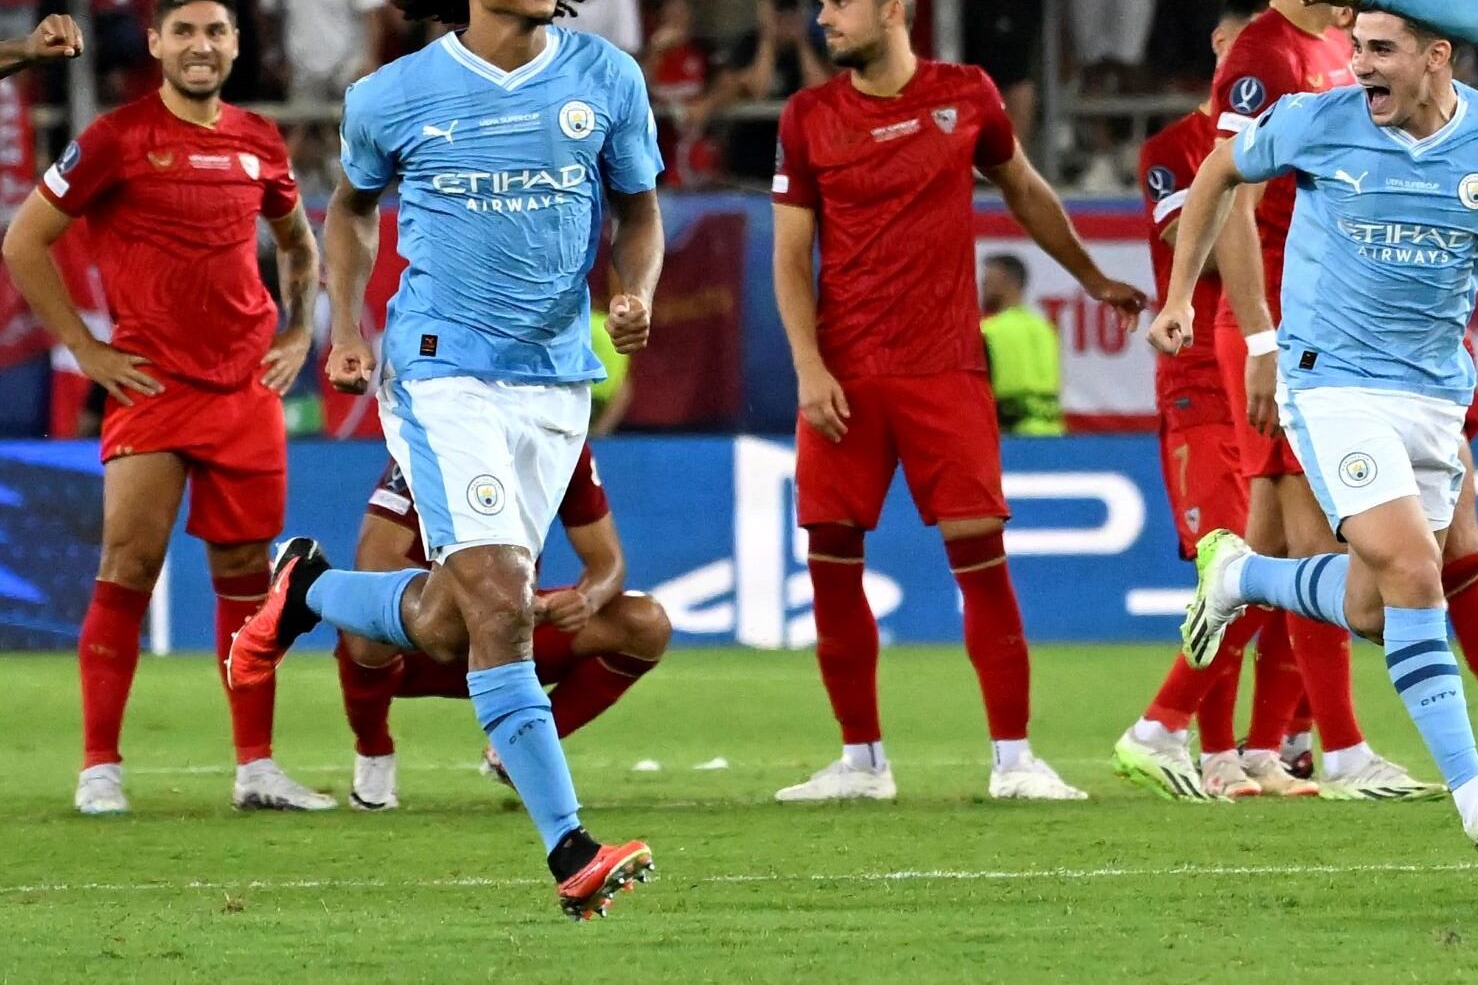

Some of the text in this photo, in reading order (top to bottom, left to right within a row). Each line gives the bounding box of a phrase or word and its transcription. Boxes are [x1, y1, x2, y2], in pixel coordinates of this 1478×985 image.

[432, 164, 587, 194] ETIHAD
[466, 193, 564, 213] AIRWAYS
[1337, 218, 1474, 248] ETIHAD
[1357, 245, 1449, 263] AIRWAYS
[1420, 689, 1457, 706] CITY
[509, 718, 547, 744] CITY
